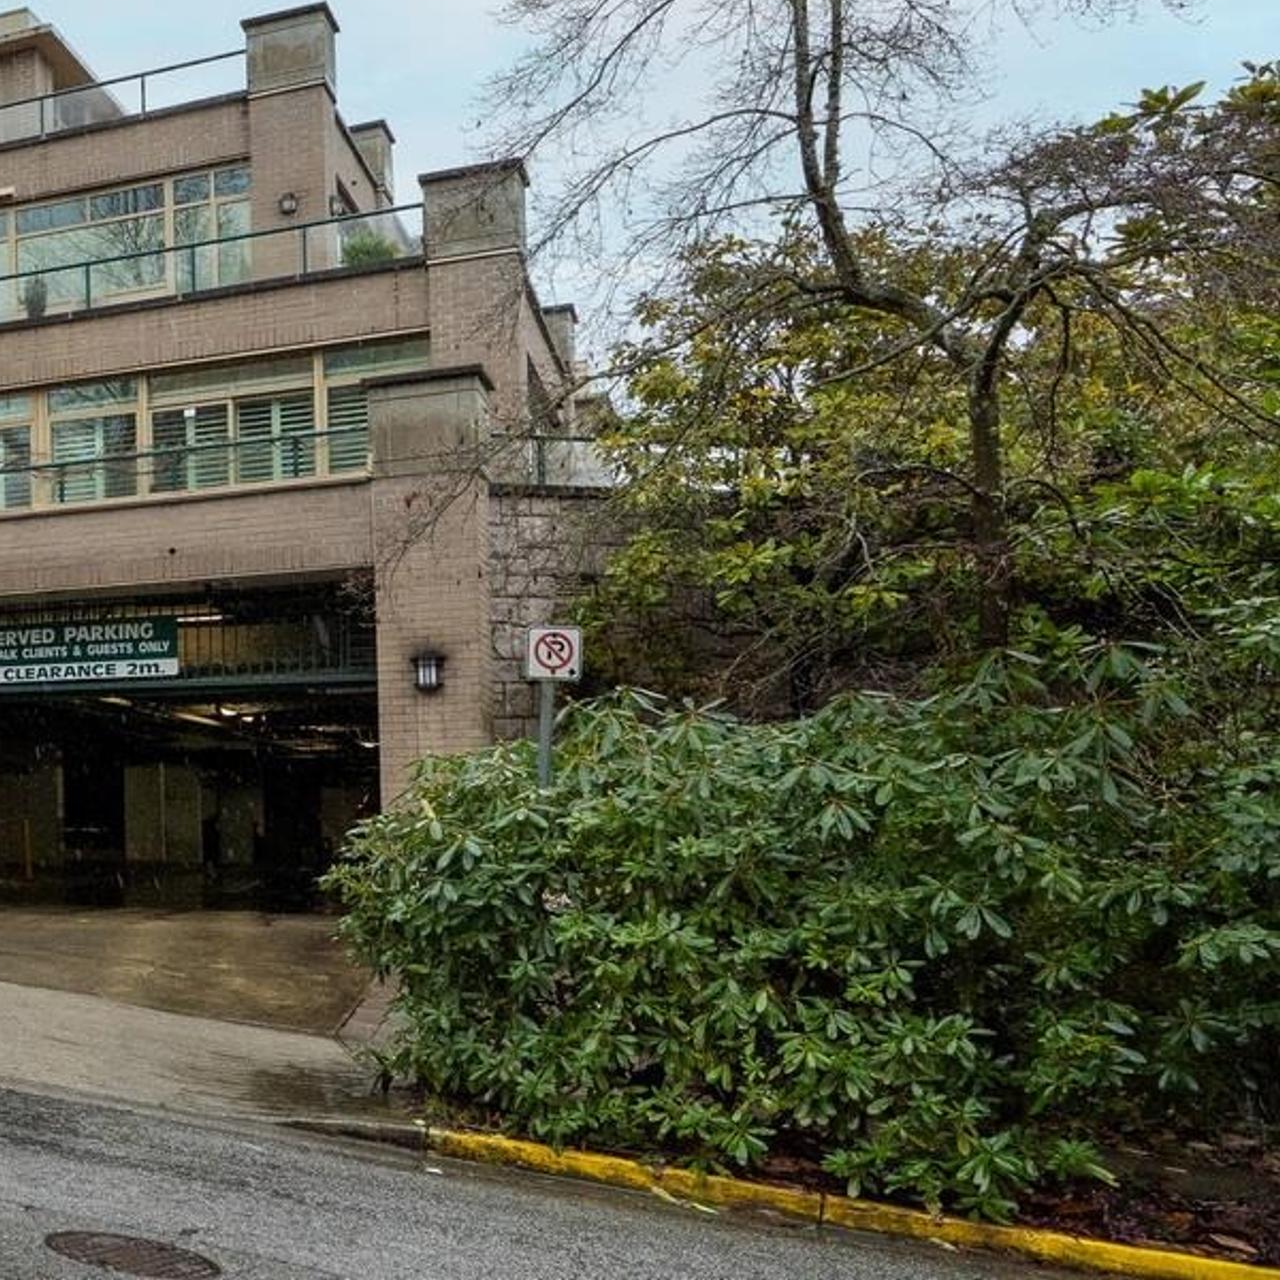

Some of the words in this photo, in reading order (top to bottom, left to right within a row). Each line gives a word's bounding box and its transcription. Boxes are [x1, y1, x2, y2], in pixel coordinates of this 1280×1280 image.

[64, 622, 154, 642] PARKING
[21, 645, 68, 659] CLIENTS
[87, 642, 134, 656] GUESTS
[138, 640, 170, 653] ONLY
[4, 663, 117, 681] CLEARANCE
